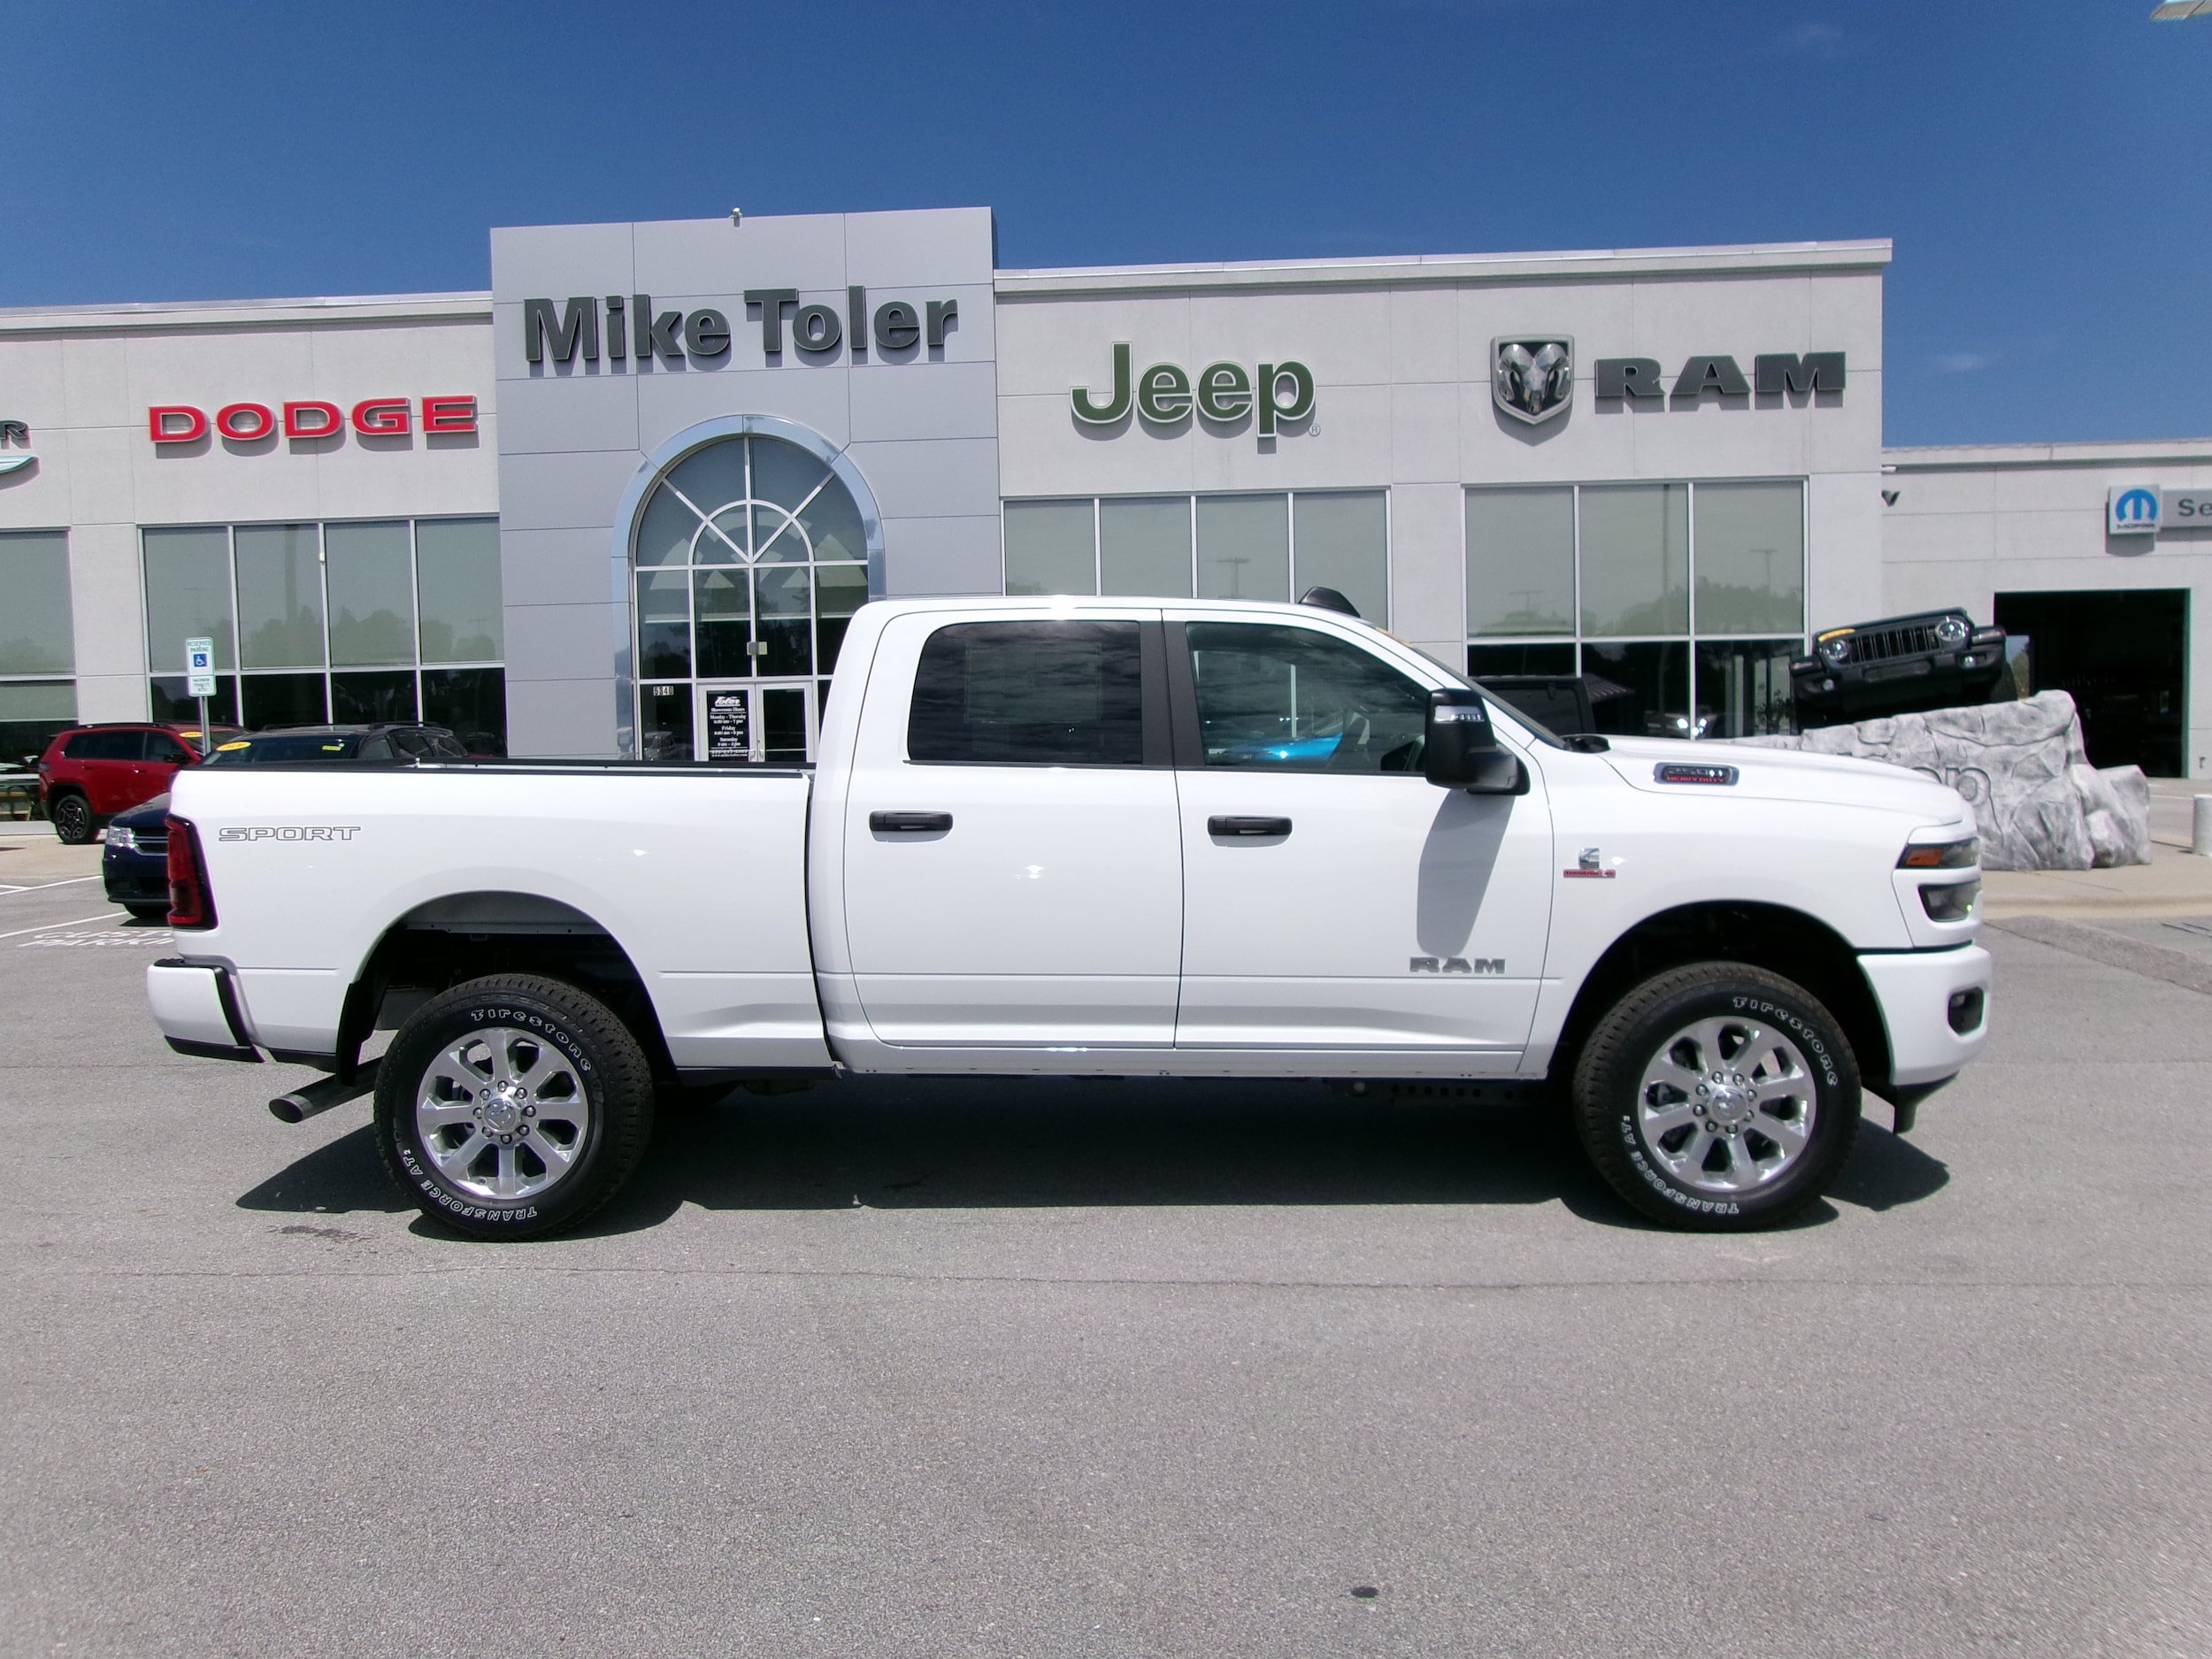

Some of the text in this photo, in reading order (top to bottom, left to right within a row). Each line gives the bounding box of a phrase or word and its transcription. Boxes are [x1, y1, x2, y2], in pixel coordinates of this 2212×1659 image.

[523, 285, 958, 361] Mike Toler
[1070, 342, 1317, 437] Jeep
[1594, 351, 1847, 396] RAM
[149, 396, 478, 442] DODGE
[219, 826, 361, 841] SPORT
[1409, 956, 1506, 974] RAM
[471, 1009, 593, 1071] Firestone
[1732, 996, 1839, 1087] Firestone
[421, 1179, 538, 1221] TRANSFORCE
[1631, 1150, 1740, 1215] TRANSFORCE
